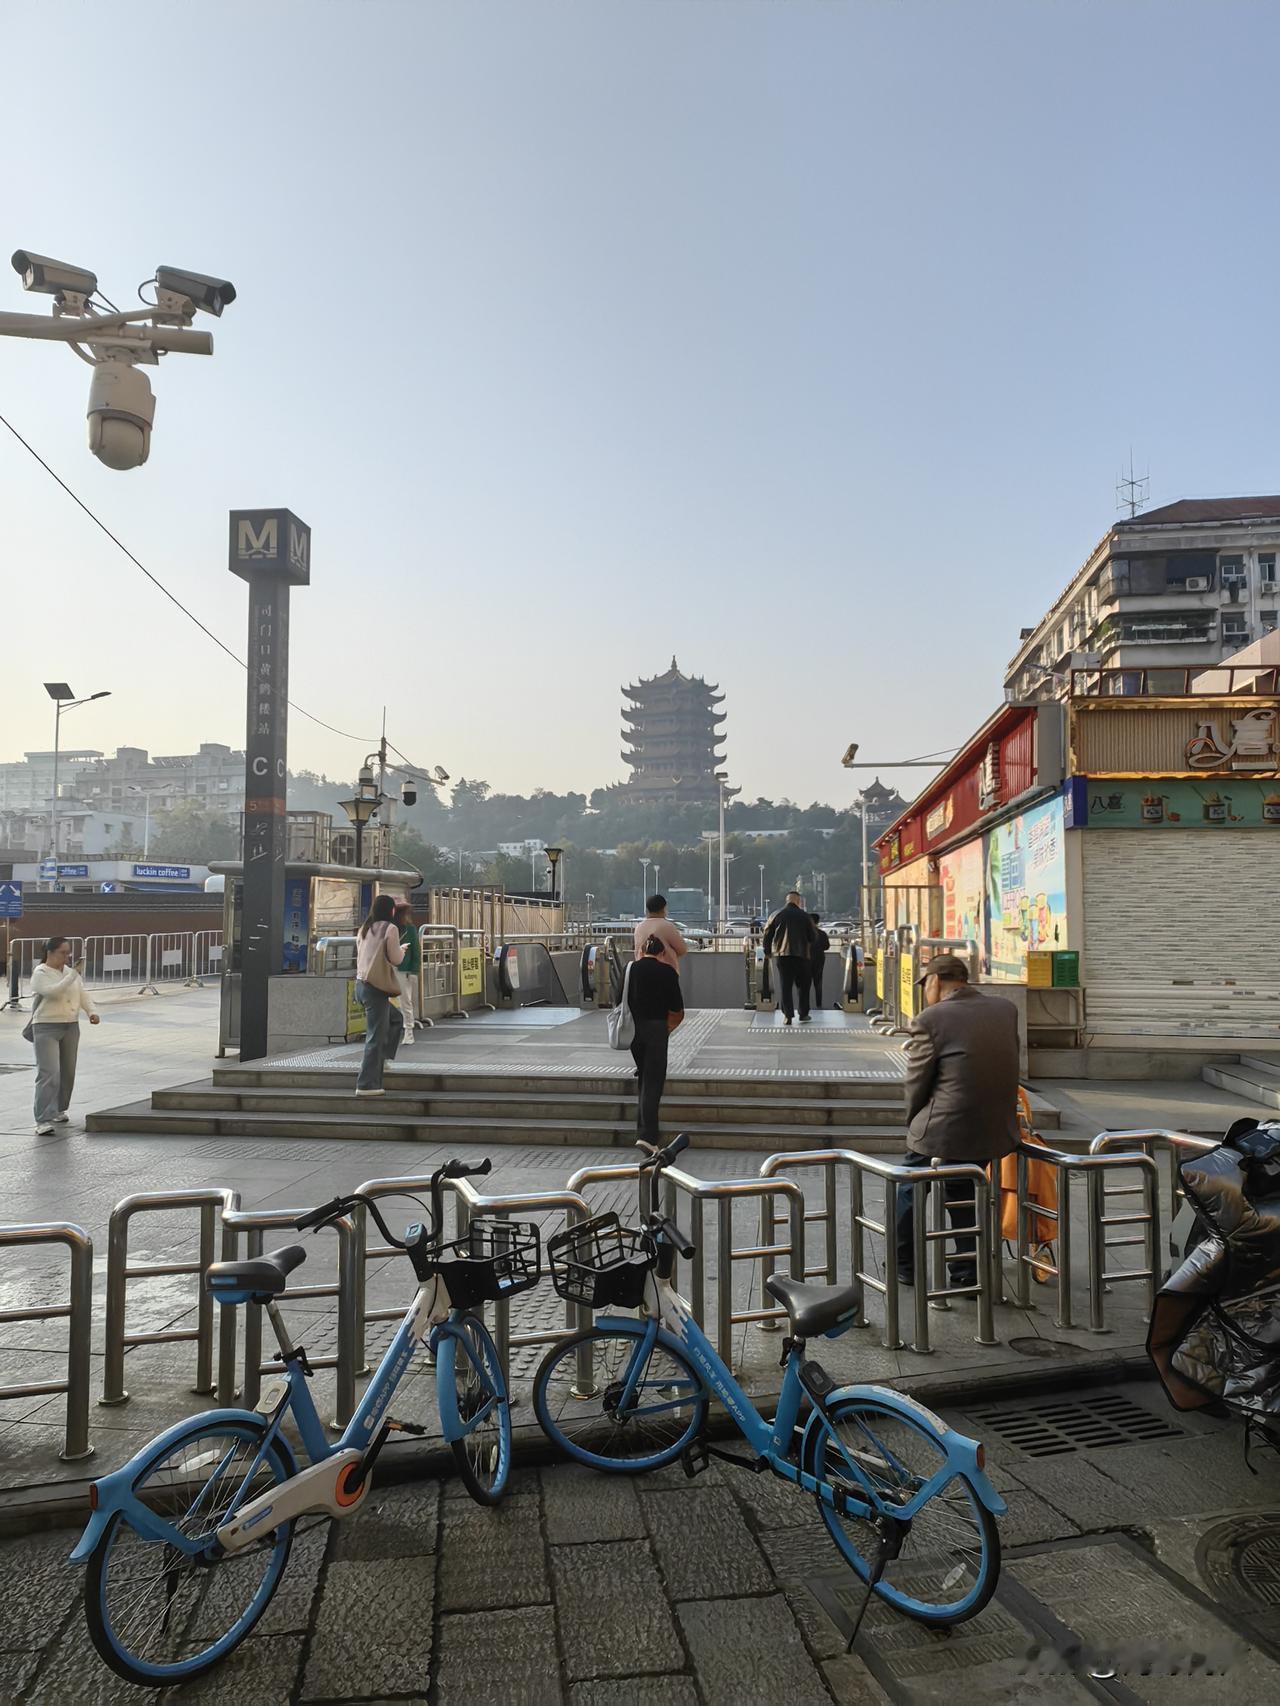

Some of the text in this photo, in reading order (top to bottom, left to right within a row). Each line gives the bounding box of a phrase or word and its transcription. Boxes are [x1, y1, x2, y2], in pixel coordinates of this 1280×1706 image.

[238, 518, 278, 559] M
[257, 604, 272, 735] 司门口黄鹤楼站
[252, 756, 269, 776] C
[276, 758, 285, 777] C
[136, 866, 157, 876] luckin
[158, 868, 179, 877] coffee
